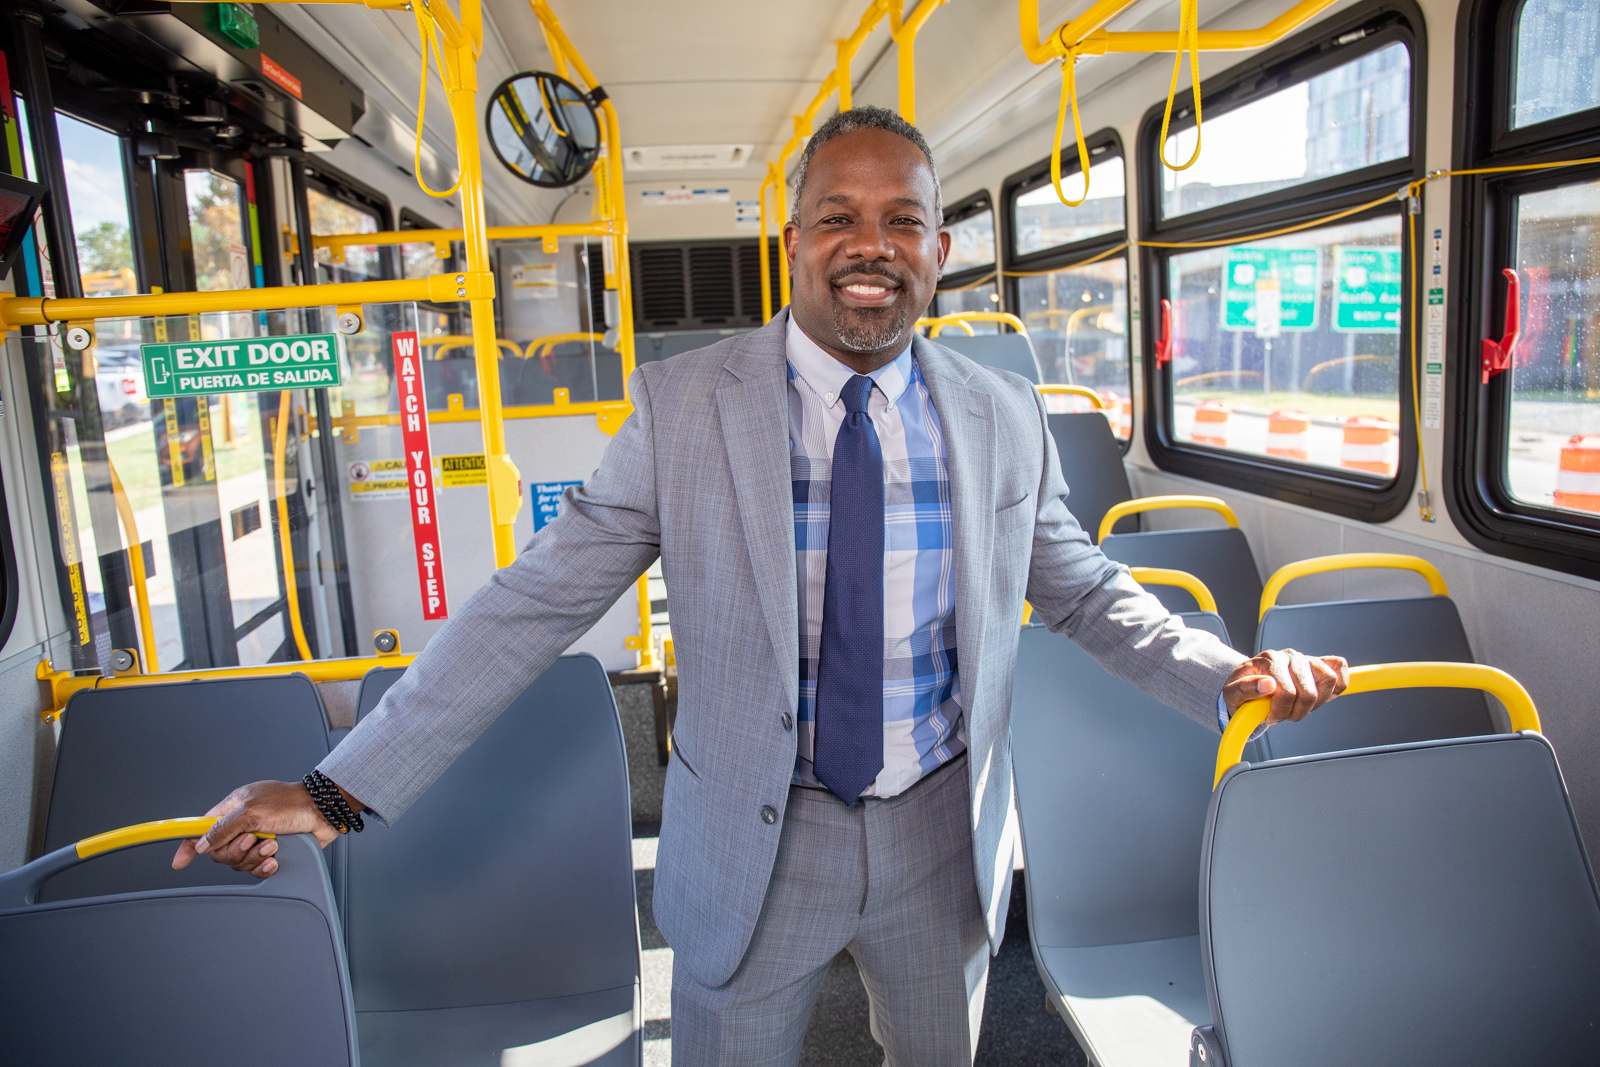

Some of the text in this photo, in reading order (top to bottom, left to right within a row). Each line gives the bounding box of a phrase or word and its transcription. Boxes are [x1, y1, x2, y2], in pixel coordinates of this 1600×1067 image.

[175, 339, 331, 369] EXIT DOOR
[179, 368, 333, 390] PUERTA DE SALIDA
[385, 461, 407, 469] CAU
[396, 338, 440, 614] WATCH YOUR STEP
[373, 481, 409, 489] PRECAU
